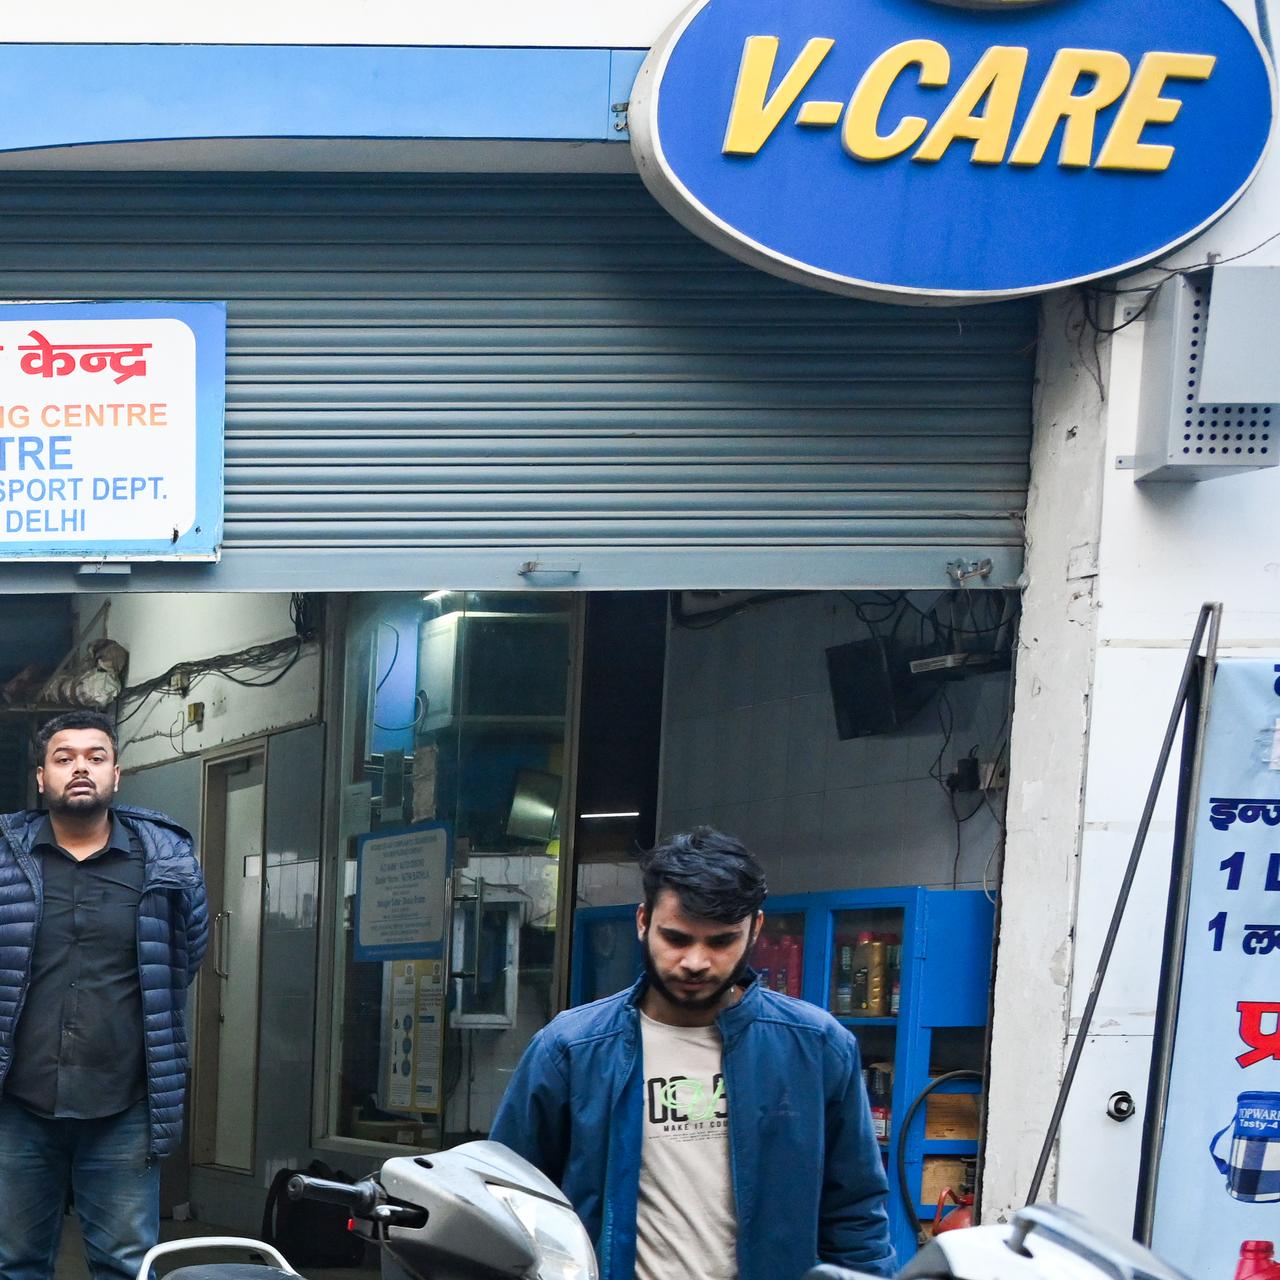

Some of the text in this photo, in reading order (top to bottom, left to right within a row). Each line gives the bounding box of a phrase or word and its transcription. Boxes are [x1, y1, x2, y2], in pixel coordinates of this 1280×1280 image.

[721, 34, 1217, 172] V-CARE
[19, 329, 153, 385] केन्द्र
[40, 402, 168, 429] CENTRE
[93, 475, 169, 501] DEPT.
[6, 508, 86, 534] DELHI
[1219, 851, 1246, 891] 1
[1208, 911, 1228, 951] 1
[663, 1123, 689, 1132] MAKE
[695, 1122, 703, 1130] IT
